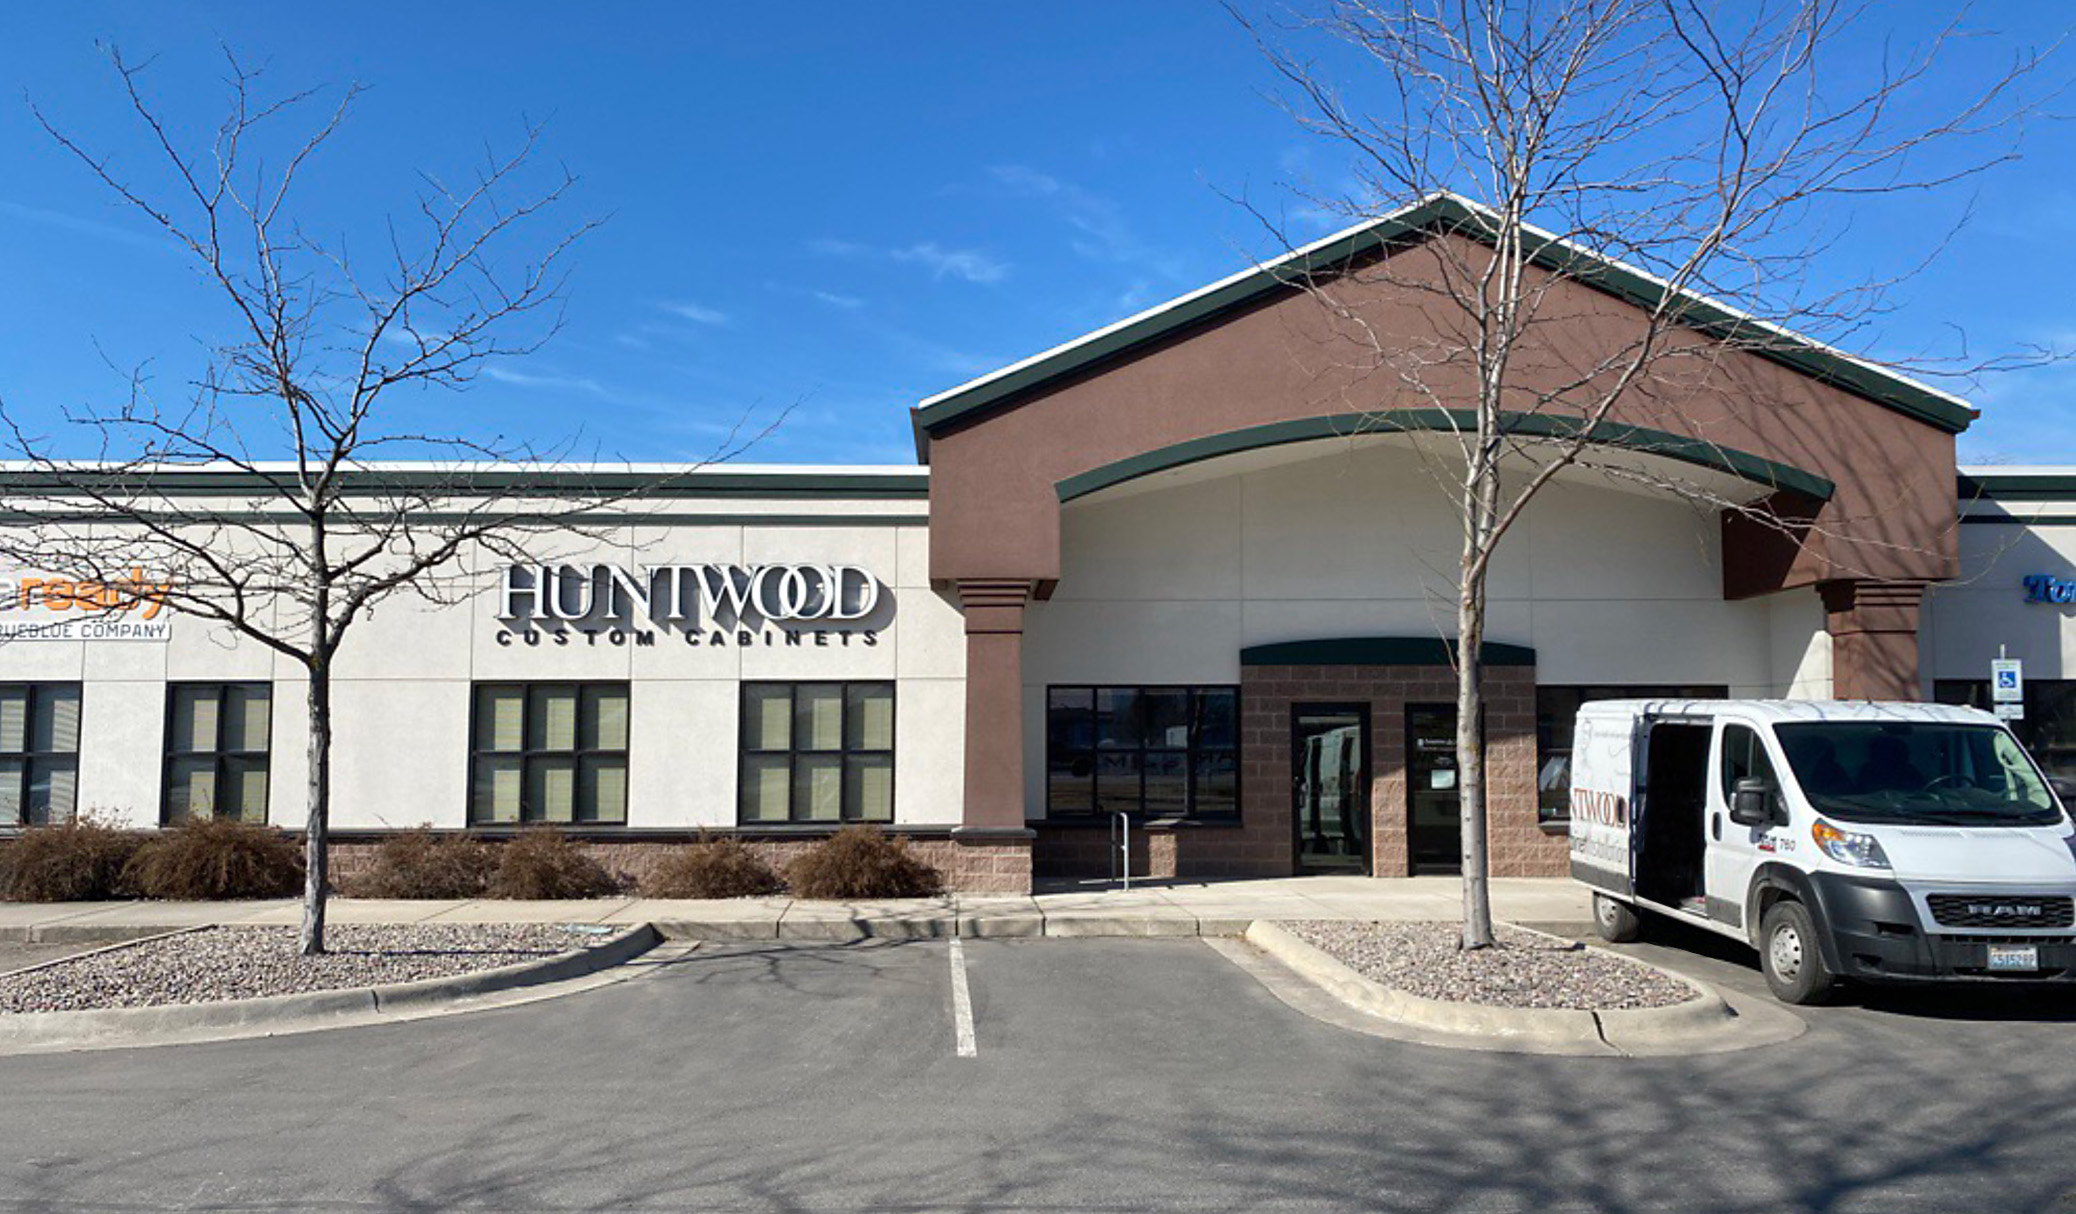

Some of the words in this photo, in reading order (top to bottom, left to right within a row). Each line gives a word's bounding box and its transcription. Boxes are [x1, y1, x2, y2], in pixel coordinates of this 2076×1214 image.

[496, 563, 879, 620] HUNTWOOD
[81, 624, 165, 638] COMPANY
[496, 629, 656, 647] CUSTOM
[685, 629, 878, 647] CABINETS
[1967, 904, 2042, 916] RAM
